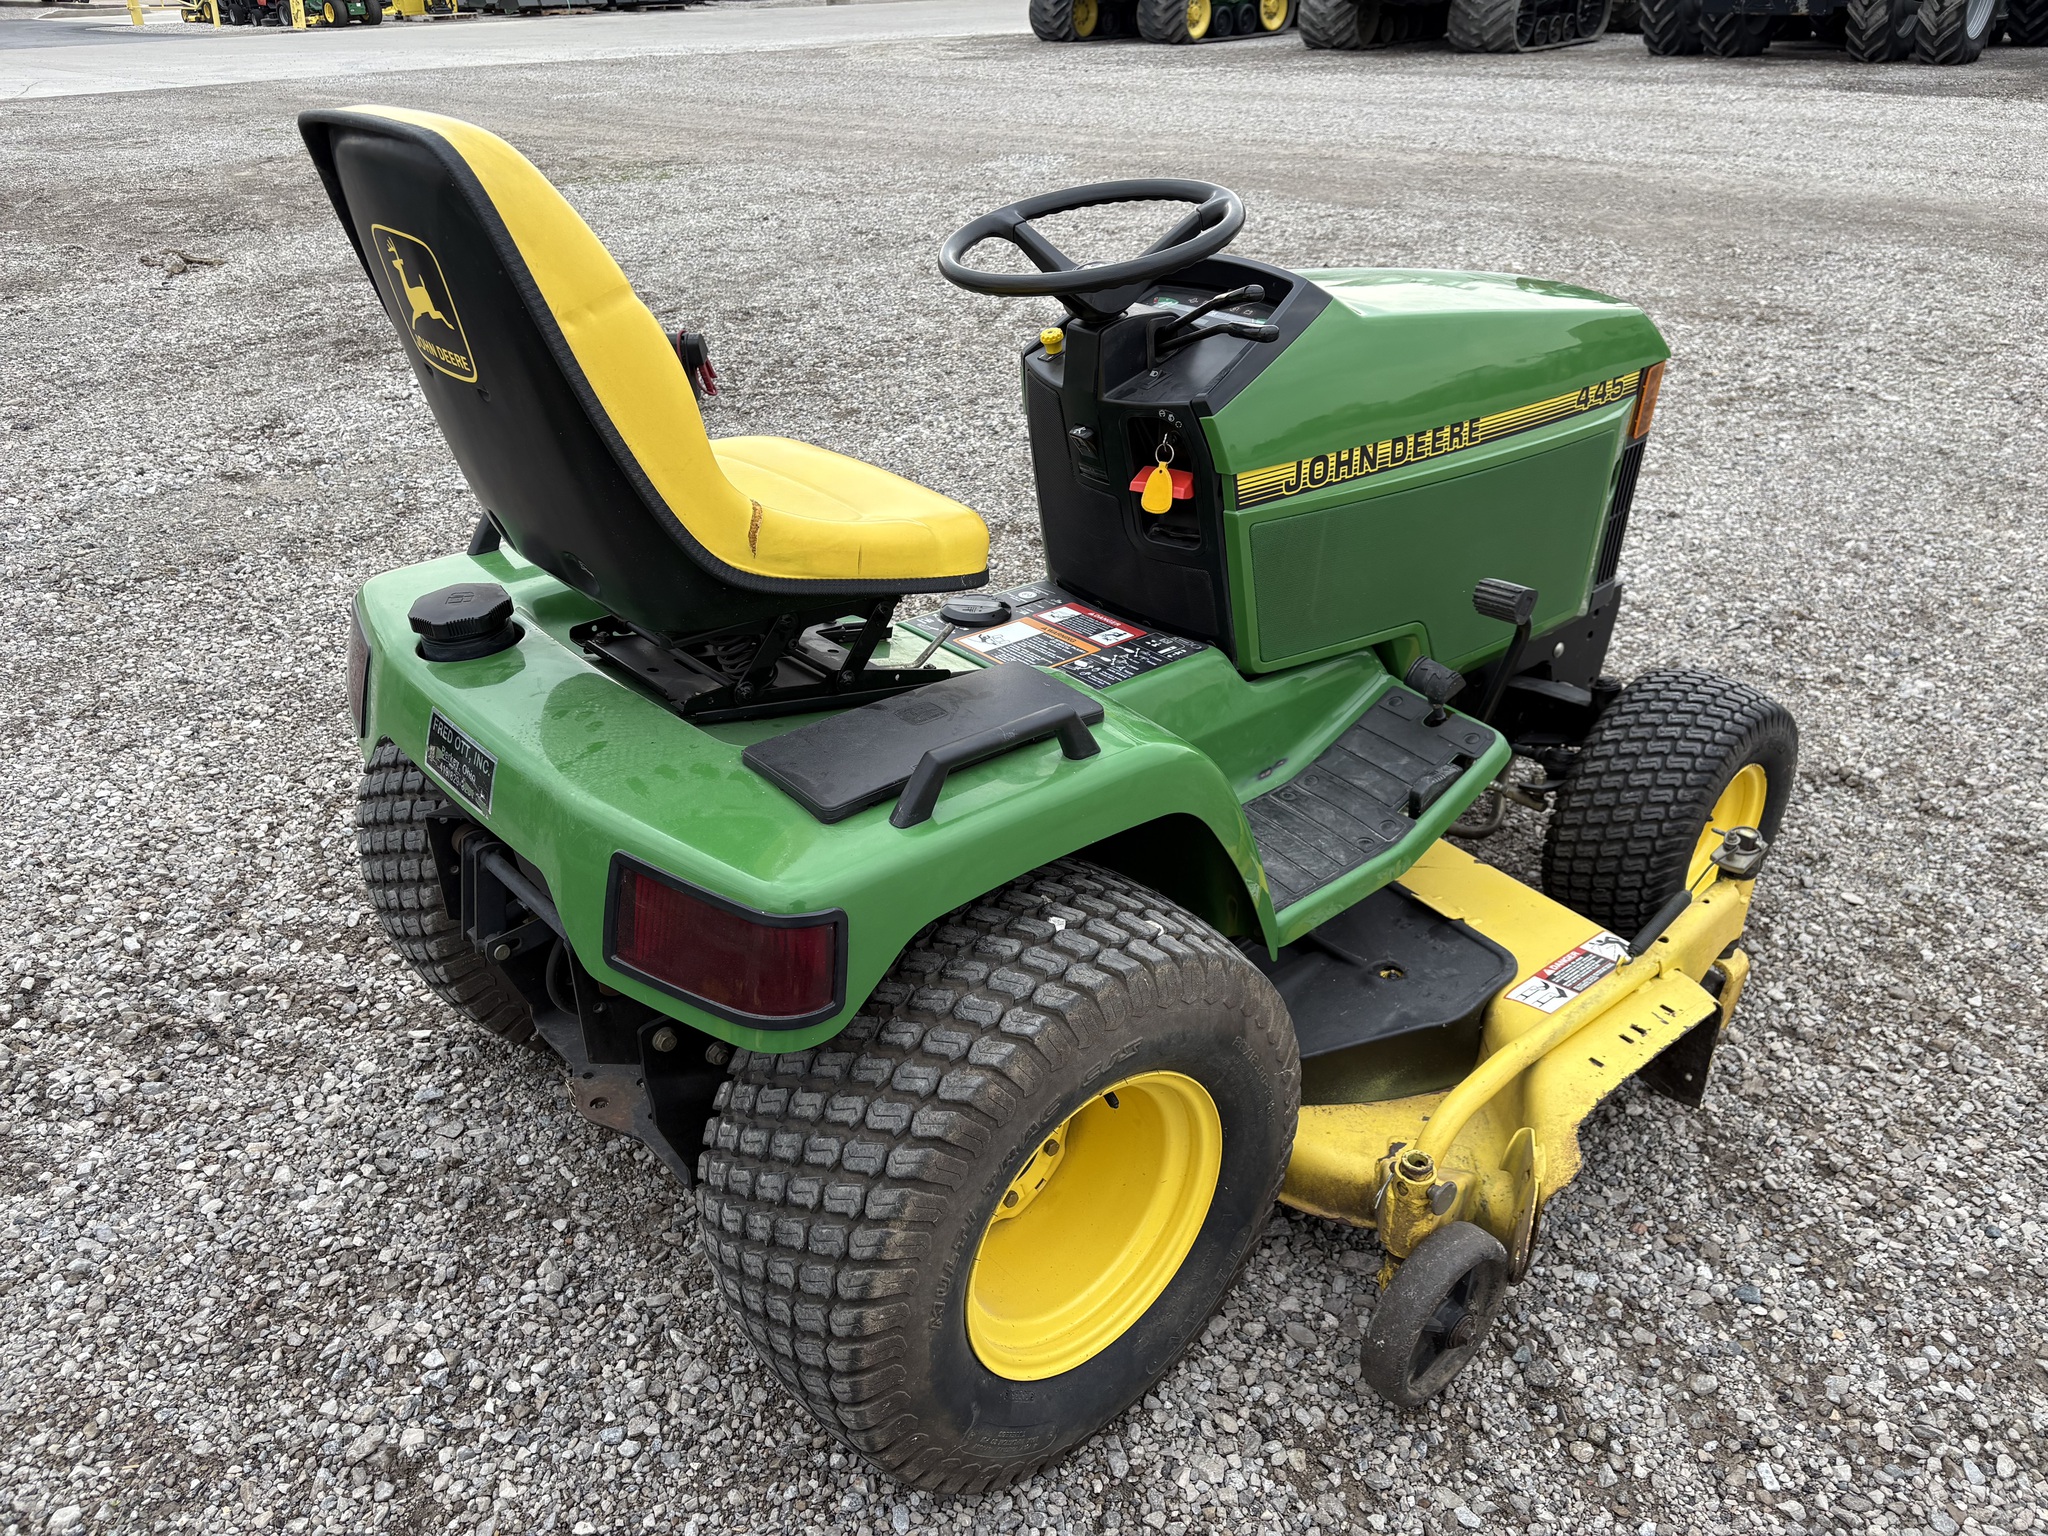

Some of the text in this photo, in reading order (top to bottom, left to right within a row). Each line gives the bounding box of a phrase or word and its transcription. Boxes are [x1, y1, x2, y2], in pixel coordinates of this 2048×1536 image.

[415, 334, 471, 371] JOHN DEERE
[1575, 375, 1625, 411] 445
[1283, 416, 1481, 495] JOHN DEERE
[1047, 628, 1077, 643] WARNING
[1093, 613, 1121, 626] DANGER
[433, 717, 491, 777] FRED OTT, INC.
[462, 764, 476, 783] Ohio
[1548, 950, 1581, 972] DANGER
[929, 1208, 978, 1329] MULTI
[980, 1096, 1061, 1196] TRAC
